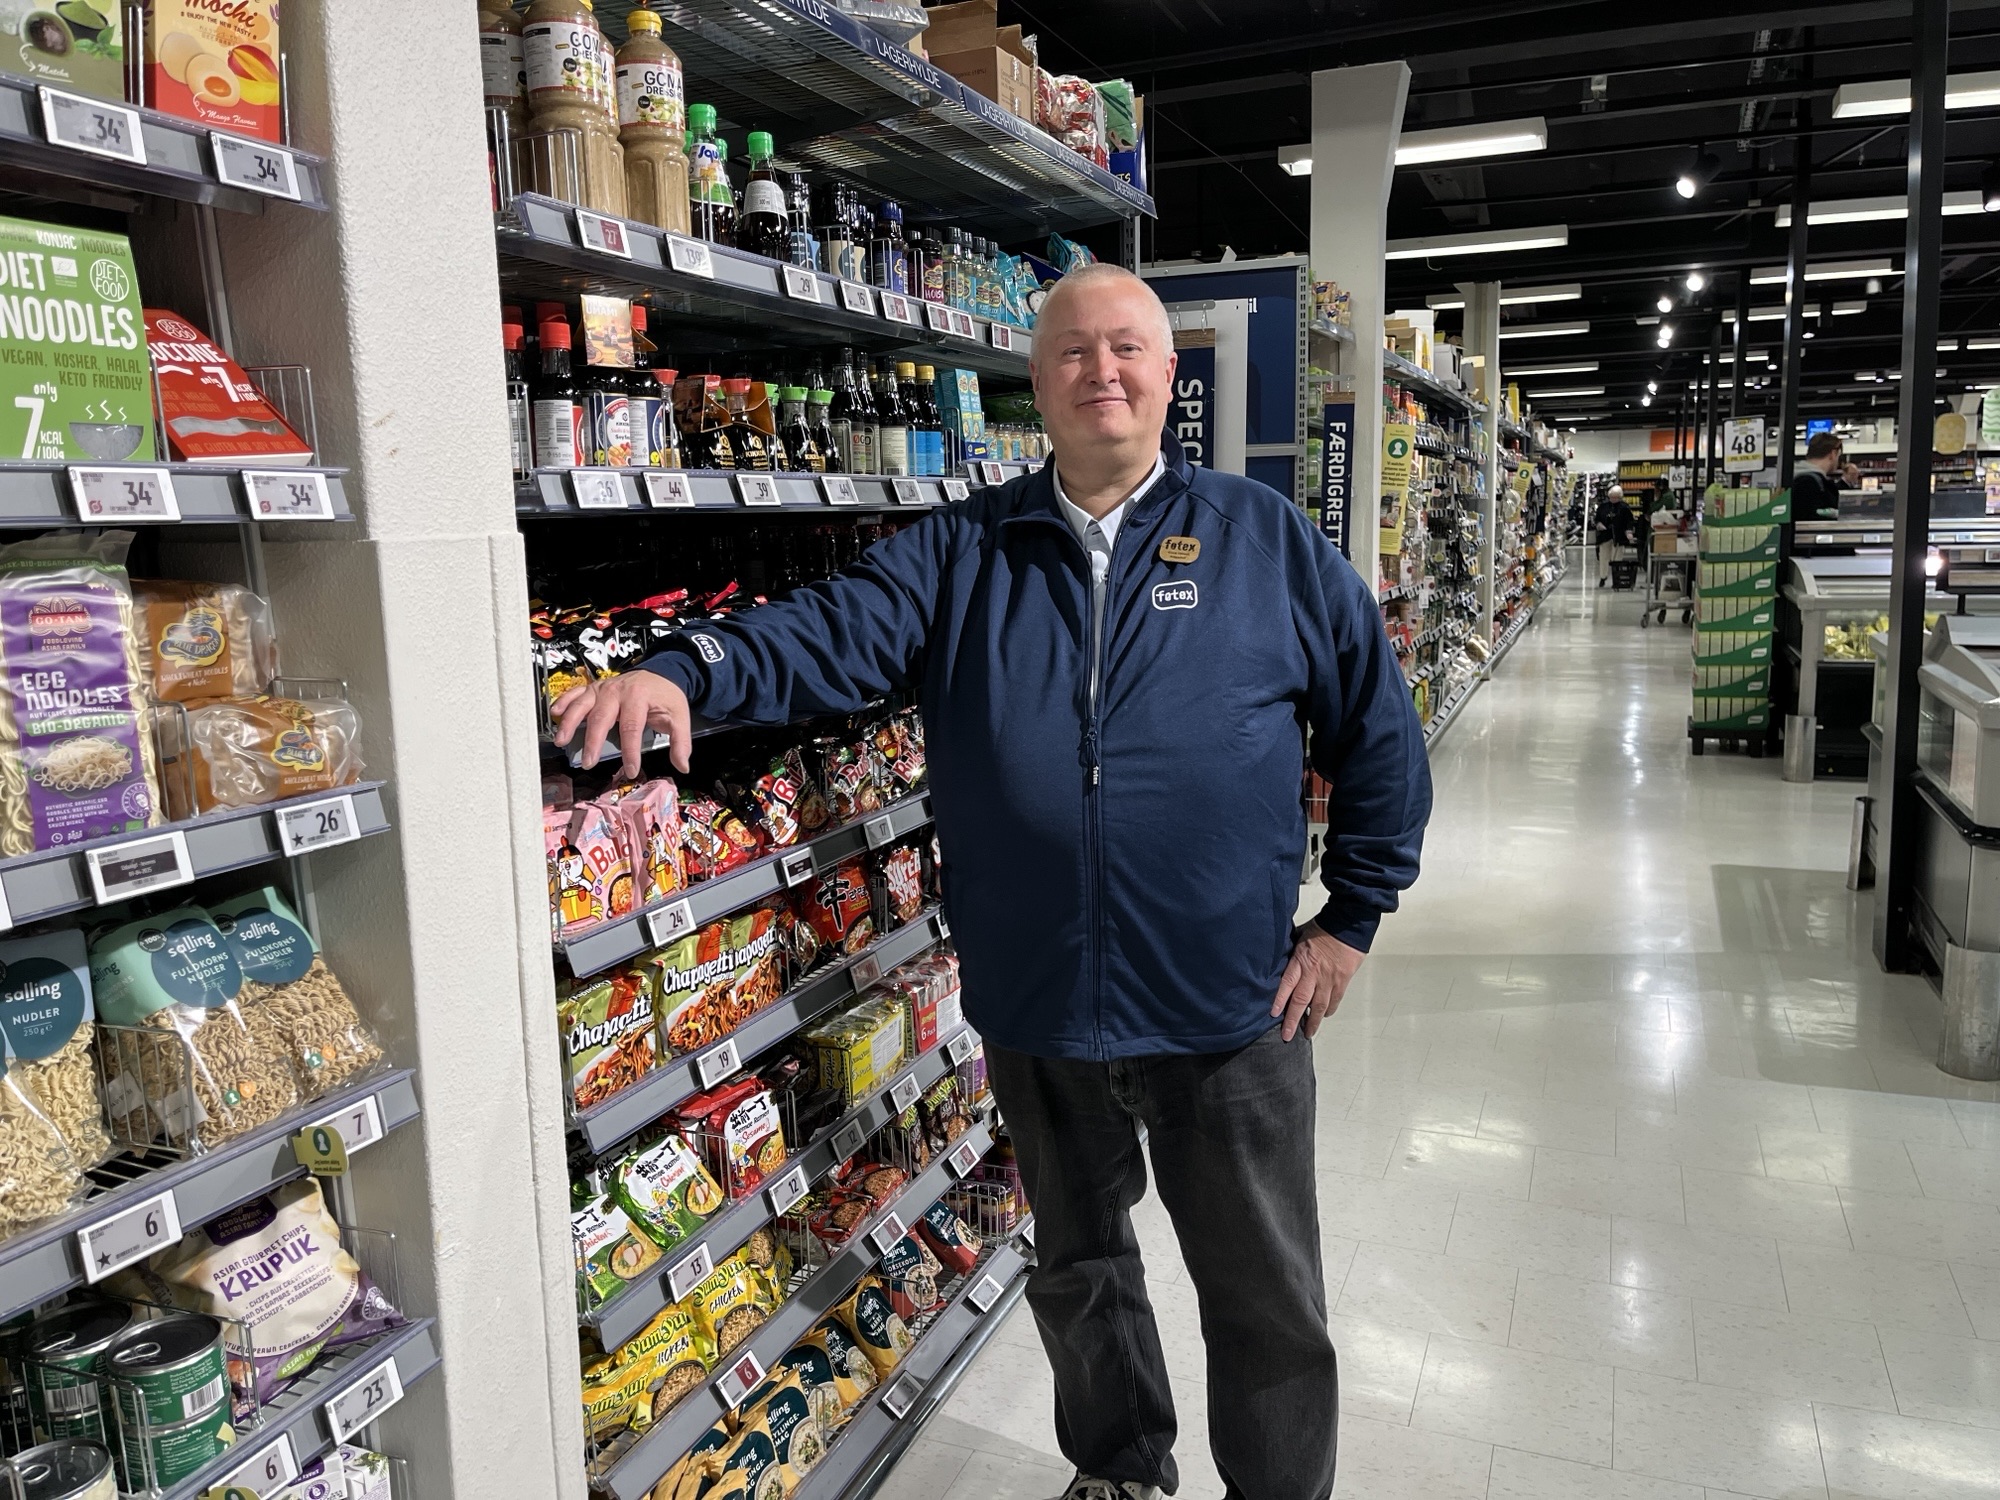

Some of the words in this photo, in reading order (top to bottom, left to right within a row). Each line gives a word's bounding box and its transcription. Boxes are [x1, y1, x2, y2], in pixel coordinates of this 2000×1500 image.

[187, 12, 205, 20] ENJOY
[207, 16, 218, 24] THE
[219, 20, 232, 28] NEW
[234, 25, 252, 37] TASTY
[37, 63, 70, 78] Matcha
[875, 37, 942, 89] LAGERHYLDE
[93, 114, 120, 144] 34
[206, 109, 230, 123] Mango
[232, 114, 257, 127] Flavour
[978, 99, 1029, 140] LAGERHYLDE
[254, 155, 278, 182] 34
[1056, 143, 1094, 179] LAGERHYLDE
[1113, 180, 1146, 208] LAGERHYLDE
[36, 230, 77, 250] KONJAC
[81, 238, 126, 257] NOODLES
[605, 229, 616, 246] 27
[686, 248, 701, 266] 139
[0, 252, 46, 291] DIET
[96, 280, 125, 300] FOOD
[800, 277, 811, 293] 29
[0, 294, 138, 350] NOODLES
[148, 342, 228, 363] UCCINE
[106, 357, 142, 374] HALAL
[59, 371, 88, 388] KETO
[92, 374, 143, 392] FRIENDLY
[200, 376, 223, 389] only
[201, 366, 241, 403] 7
[33, 383, 58, 403] only
[14, 396, 45, 459] 7
[1177, 378, 1205, 468] SPEC
[40, 430, 65, 445] KCAL
[1731, 434, 1756, 454] 48
[1672, 474, 1683, 482] 65
[123, 481, 152, 506] 34
[287, 484, 311, 506] 34
[668, 481, 682, 498] 44
[756, 482, 769, 497] 39
[1165, 539, 1196, 552] føtex
[1156, 589, 1194, 602] føtex
[41, 644, 61, 653] ASIAN
[62, 643, 86, 652] FAMILY
[43, 637, 83, 645] FOODLOVING
[579, 627, 641, 670] Soba
[697, 636, 718, 660] føtex
[21, 671, 67, 691] EGG
[161, 670, 201, 682] WHOLEWHEAT
[26, 686, 123, 711] NOODLES
[32, 713, 127, 735] BIO-ORGANIC
[316, 809, 339, 834] 26
[888, 847, 922, 892] SUPER
[899, 879, 921, 905] SPICY
[239, 920, 281, 941] salling
[669, 910, 684, 929] 24
[168, 932, 217, 958] salling
[244, 936, 296, 961] FULDKORNS
[171, 952, 229, 981] FULDKORNS
[259, 947, 293, 966] NUDLER
[187, 963, 227, 985] NUDLER
[664, 950, 735, 995] Chapagetti
[4, 980, 62, 1004] salling
[13, 1006, 60, 1027] NUDLER
[921, 1029, 927, 1041] 6
[718, 1051, 729, 1068] 19
[729, 1094, 768, 1130] 出前一丁
[753, 1109, 770, 1125] Ramen
[352, 1112, 364, 1136] 7
[742, 1118, 768, 1143] Sesame
[635, 1142, 681, 1180] 出前一丁
[664, 1155, 681, 1173] Ramen
[788, 1178, 799, 1195] 12
[145, 1211, 158, 1237] 6
[218, 1209, 262, 1231] FOODLOVING
[219, 1222, 243, 1240] ASIAN
[586, 1219, 607, 1238] Ramen
[212, 1263, 241, 1281] ASIAN
[241, 1239, 281, 1268] GOURMET
[281, 1224, 308, 1244] CHIPS
[218, 1233, 320, 1303] KRUPUK
[690, 1257, 702, 1277] 13
[248, 1292, 270, 1308] CHIPS
[270, 1284, 283, 1297] AUX
[283, 1264, 315, 1288] CREVETTES
[692, 1260, 748, 1306] YumYum
[985, 1283, 996, 1293] 2
[708, 1284, 745, 1314] CHICKEN
[241, 1308, 256, 1321] PAN
[255, 1304, 264, 1316] DE
[281, 1354, 302, 1375] ASIAN
[744, 1367, 753, 1380] 6
[362, 1378, 383, 1409] 23
[903, 1382, 913, 1395] 3
[771, 1412, 801, 1439] YLLINGE-
[265, 1456, 278, 1480] 6
